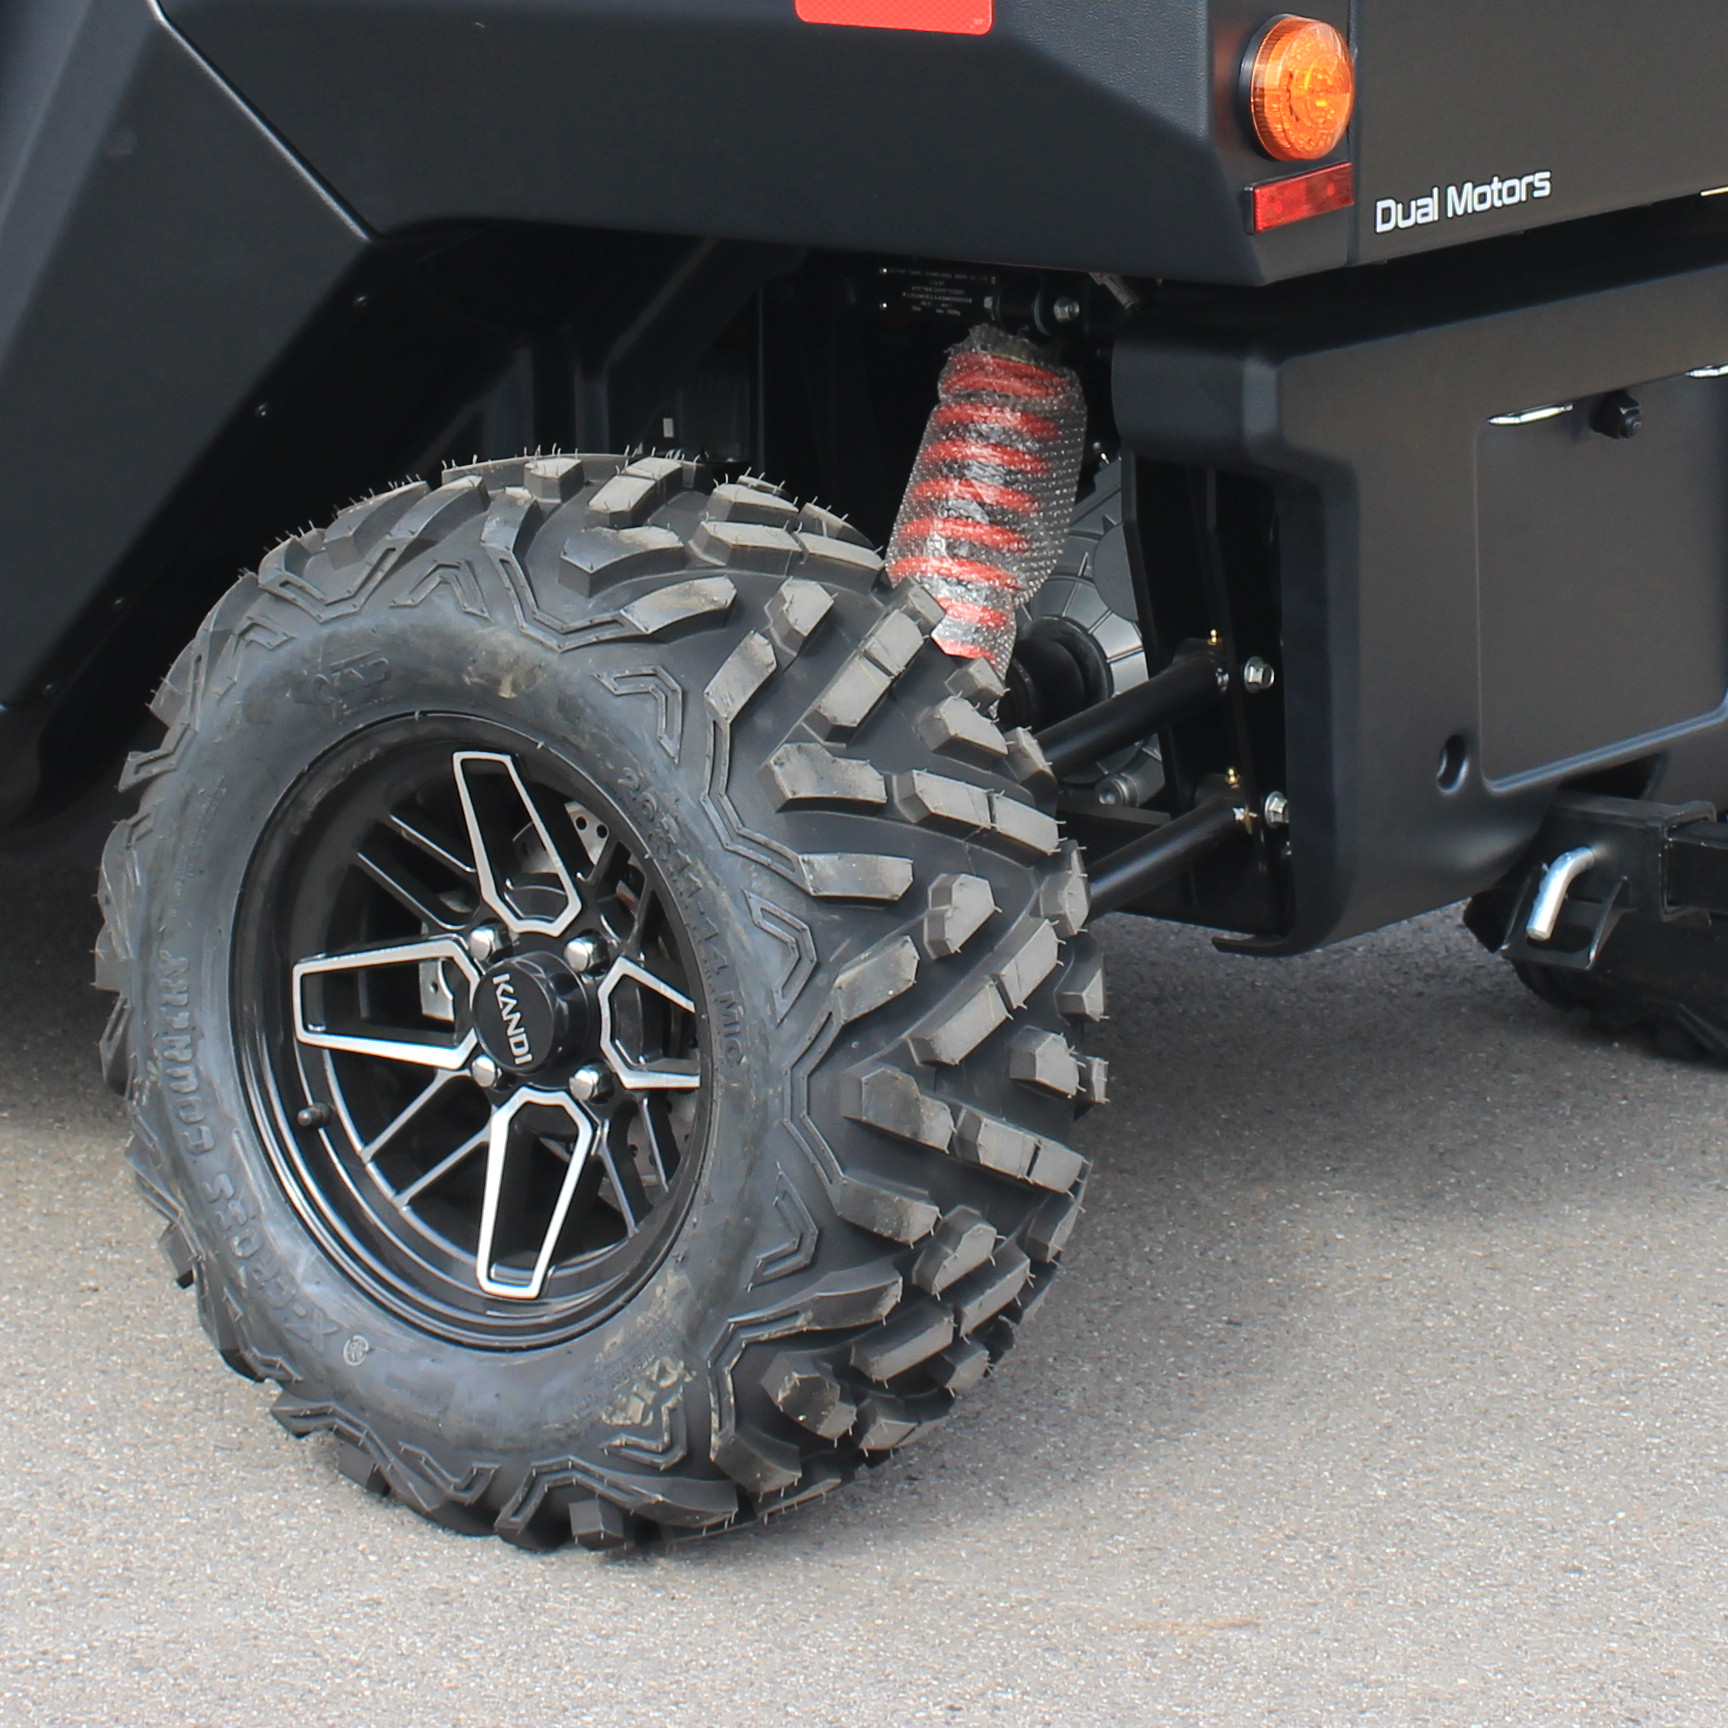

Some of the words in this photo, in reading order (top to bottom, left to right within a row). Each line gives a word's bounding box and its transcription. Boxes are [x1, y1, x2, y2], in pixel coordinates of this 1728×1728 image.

[1375, 192, 1440, 234] Dual
[1446, 170, 1552, 219] Motors
[491, 973, 536, 1064] KANDI
